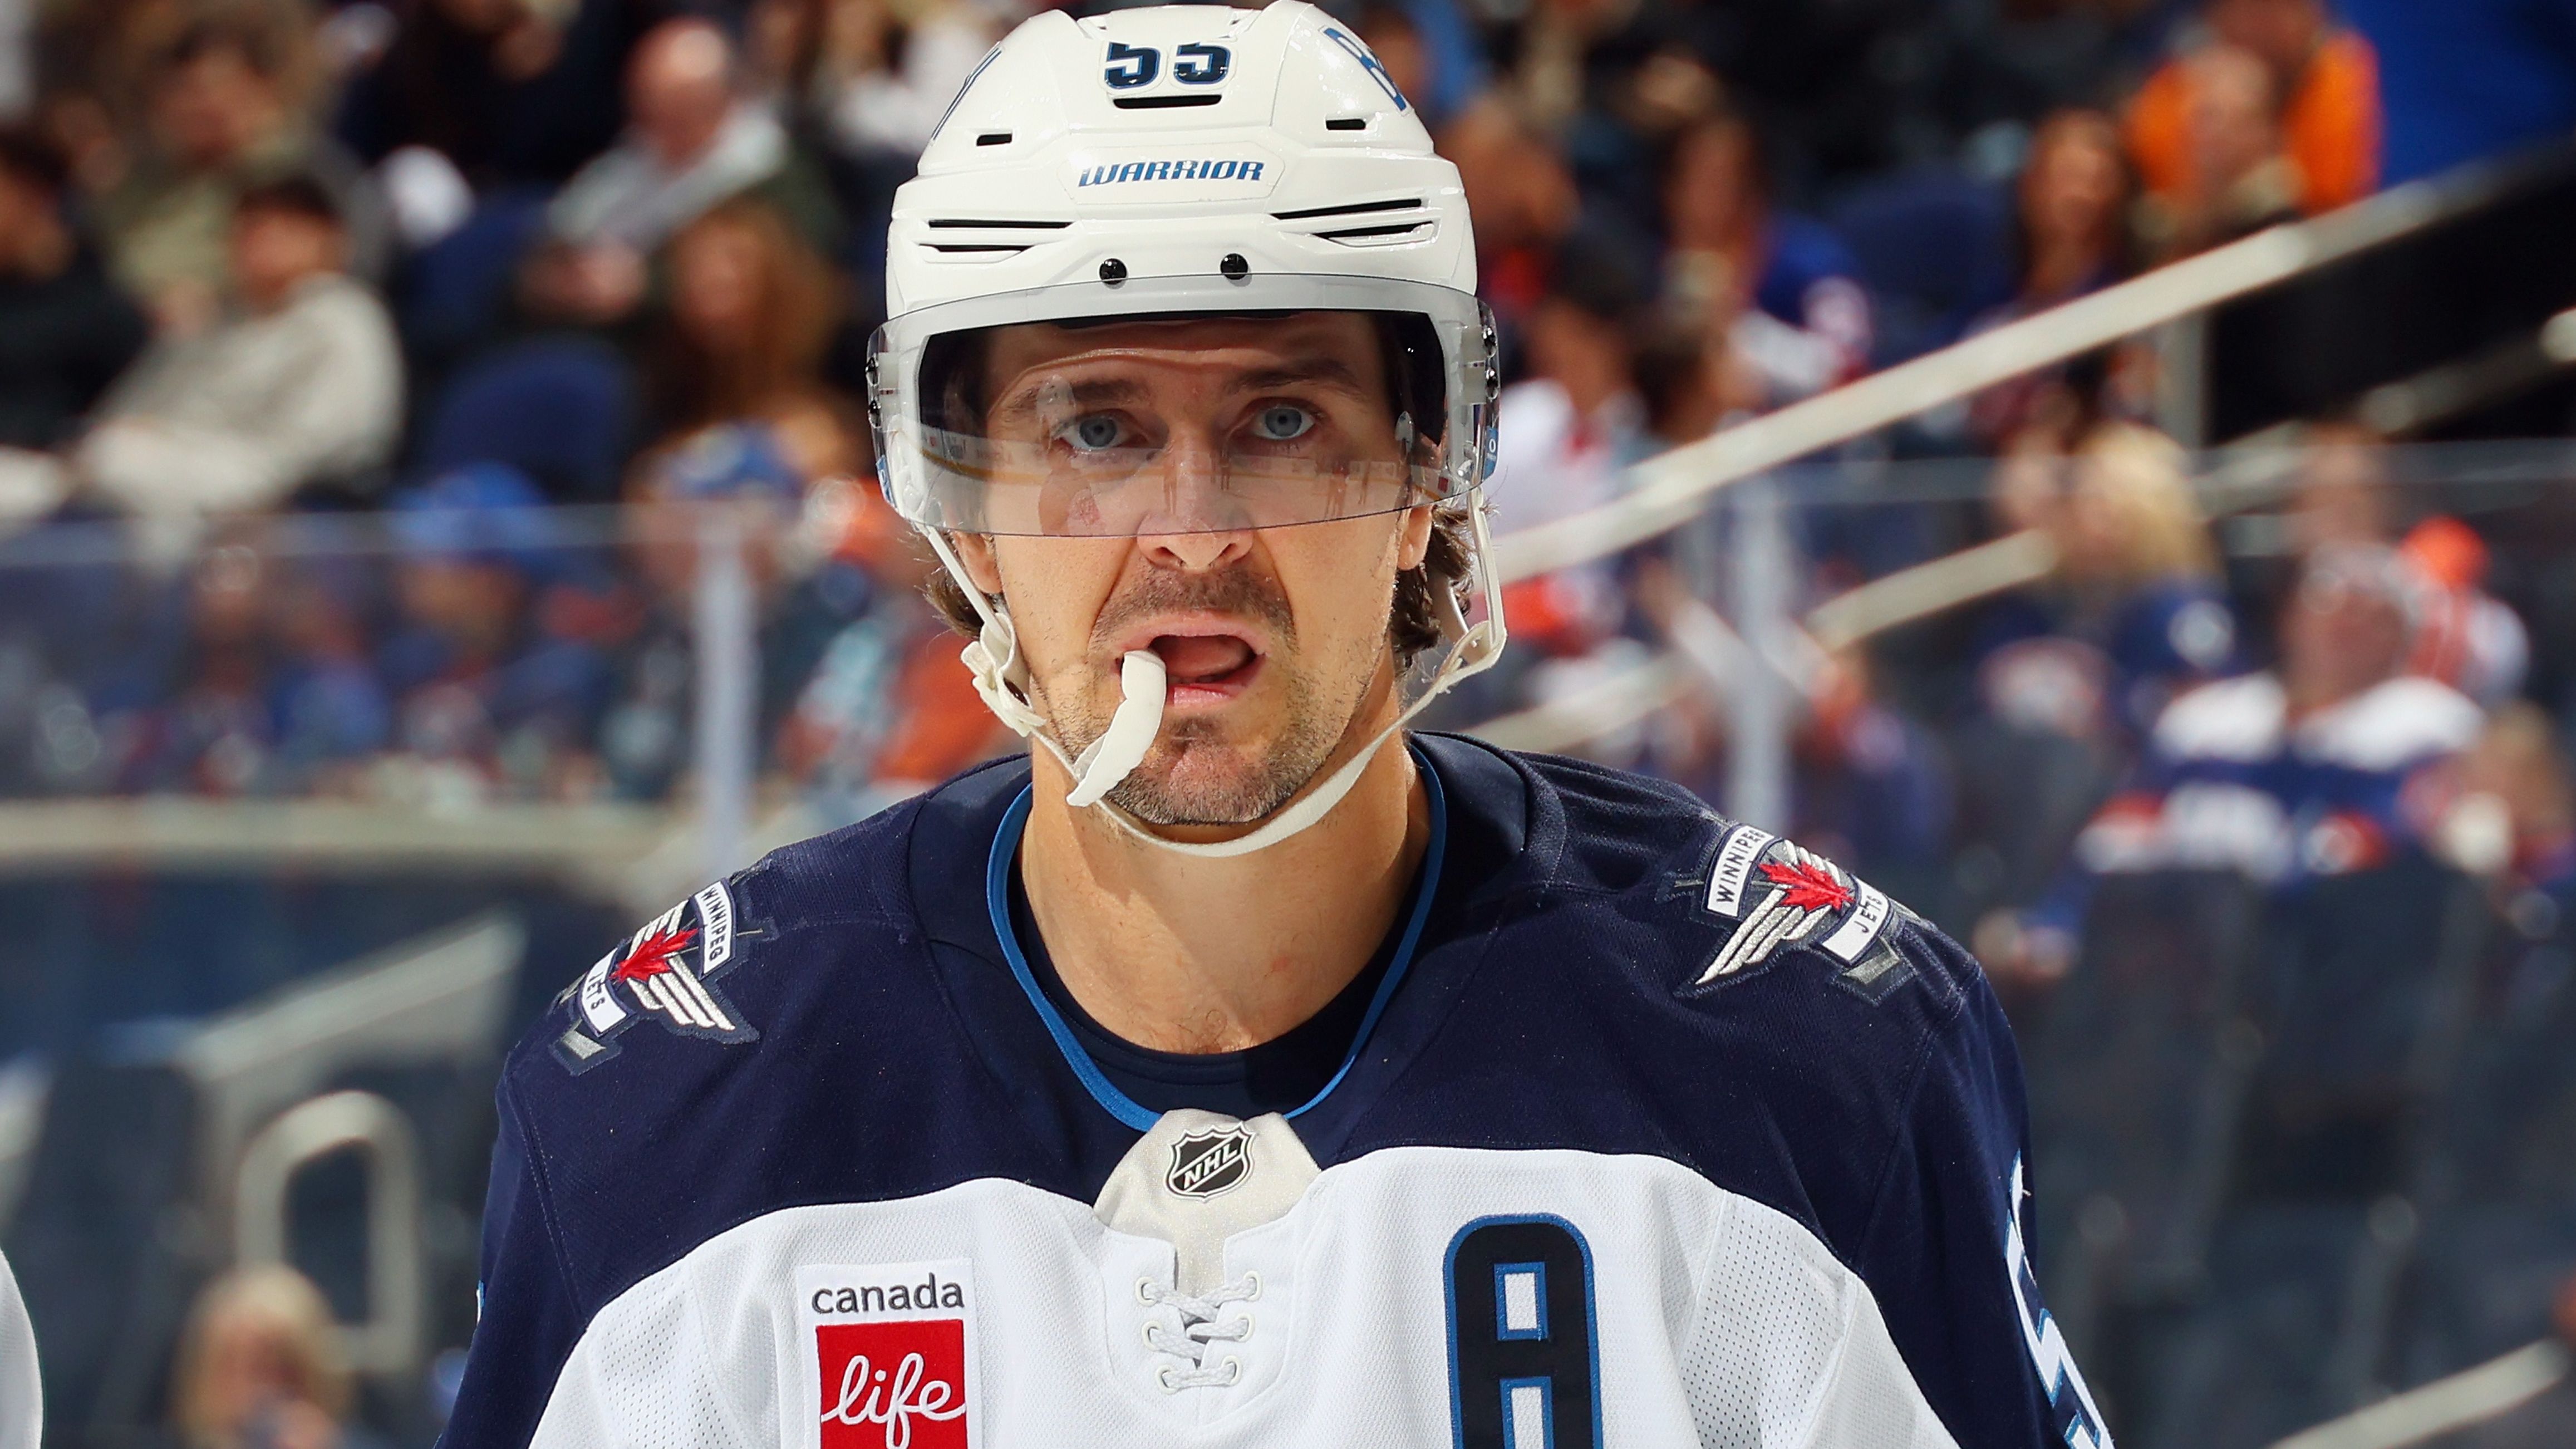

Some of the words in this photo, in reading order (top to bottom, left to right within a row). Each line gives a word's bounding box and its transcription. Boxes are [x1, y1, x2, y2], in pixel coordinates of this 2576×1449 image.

[1104, 41, 1231, 90] 55
[1078, 160, 1265, 188] WARRIOR
[701, 886, 727, 962] WINNIPEG
[1183, 1143, 1238, 1190] NHL
[811, 1271, 965, 1315] canada
[1443, 1212, 1603, 1449] A
[820, 1352, 966, 1449] life
